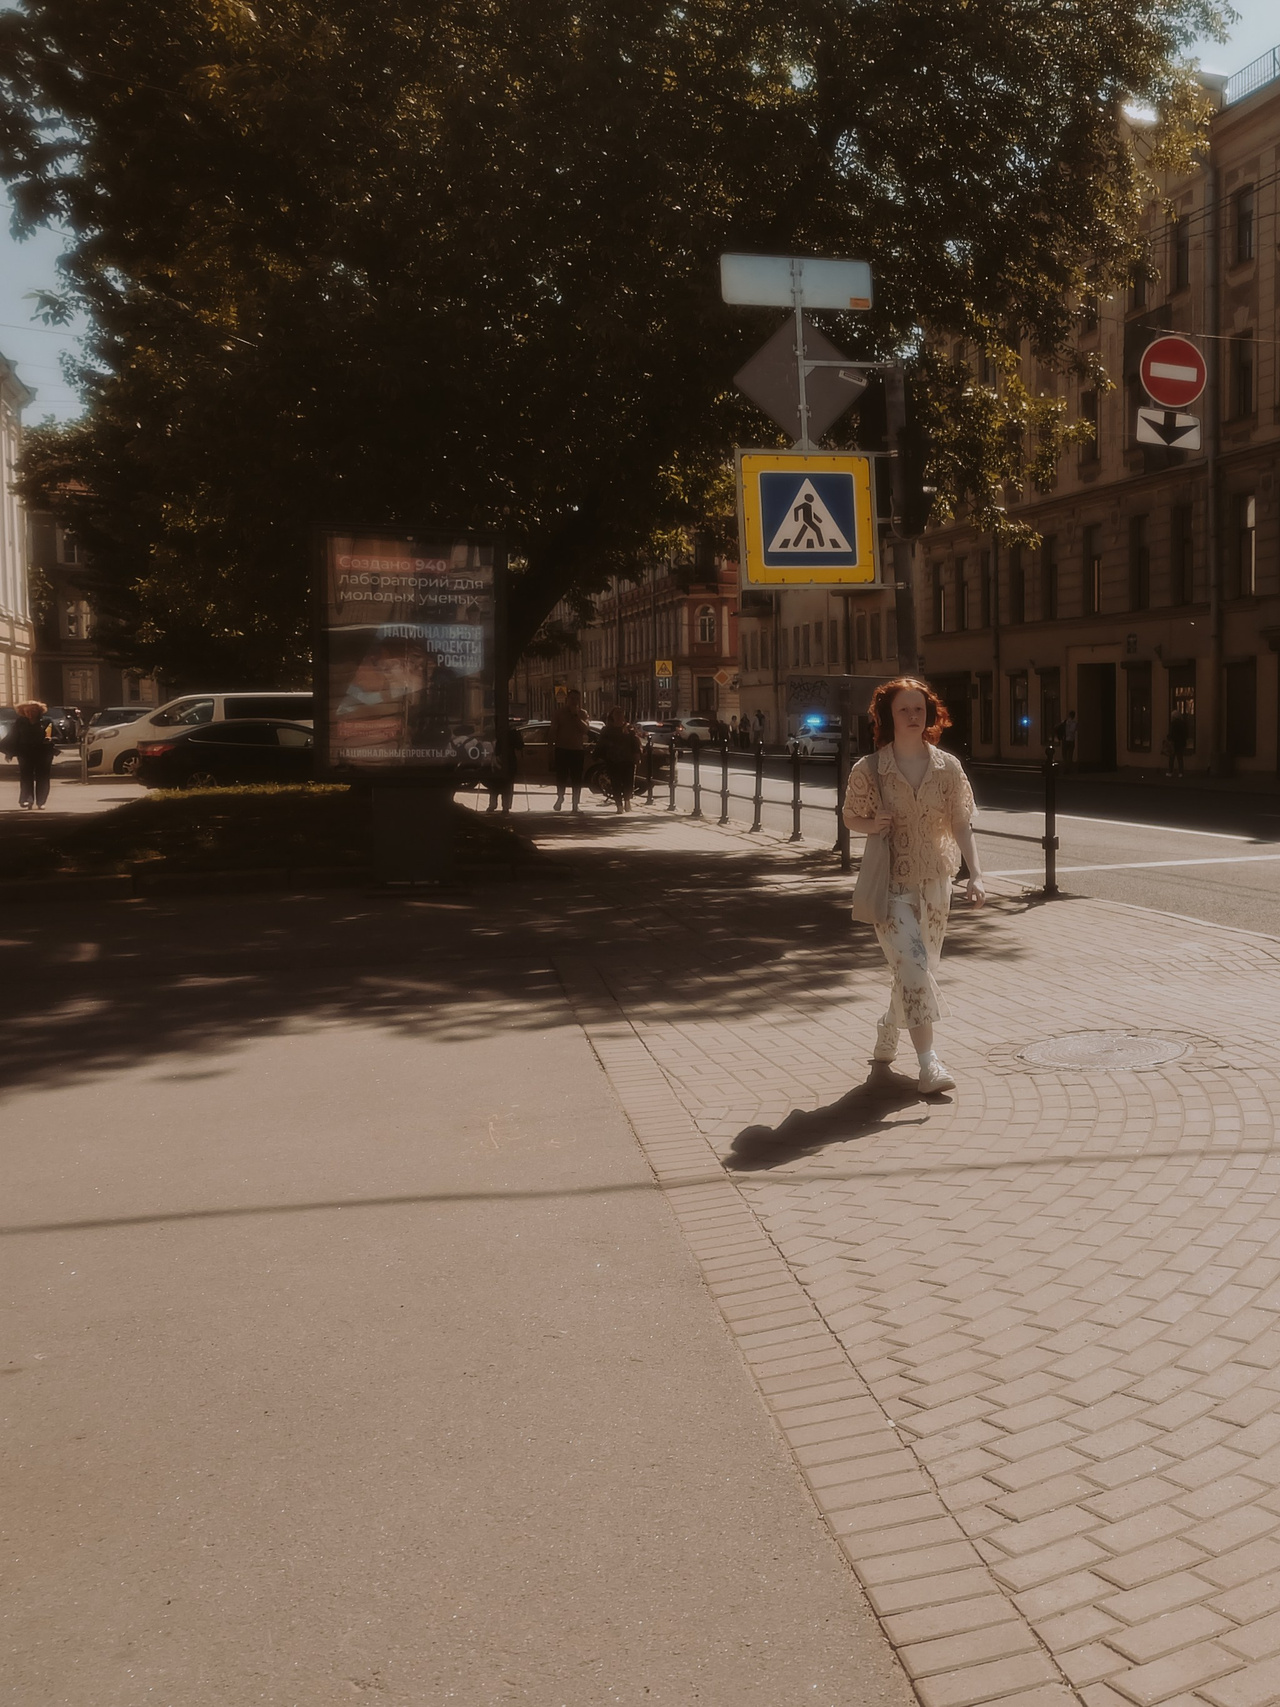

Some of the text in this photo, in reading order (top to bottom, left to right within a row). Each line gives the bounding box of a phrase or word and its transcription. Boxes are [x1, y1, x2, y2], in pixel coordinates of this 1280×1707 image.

[339, 555, 447, 572] Создано 940
[339, 572, 484, 591] лабораторий для
[340, 591, 480, 606] молодых ученых
[383, 625, 482, 640] НАЦИОНАЛЬНЫЕ
[427, 640, 482, 654] ПРОЕКТЫ
[437, 654, 482, 668] РОССИИ
[340, 746, 490, 760] НАЦИОНАЛЬНЫЕПРОЕКТЫ.РФ 0+
